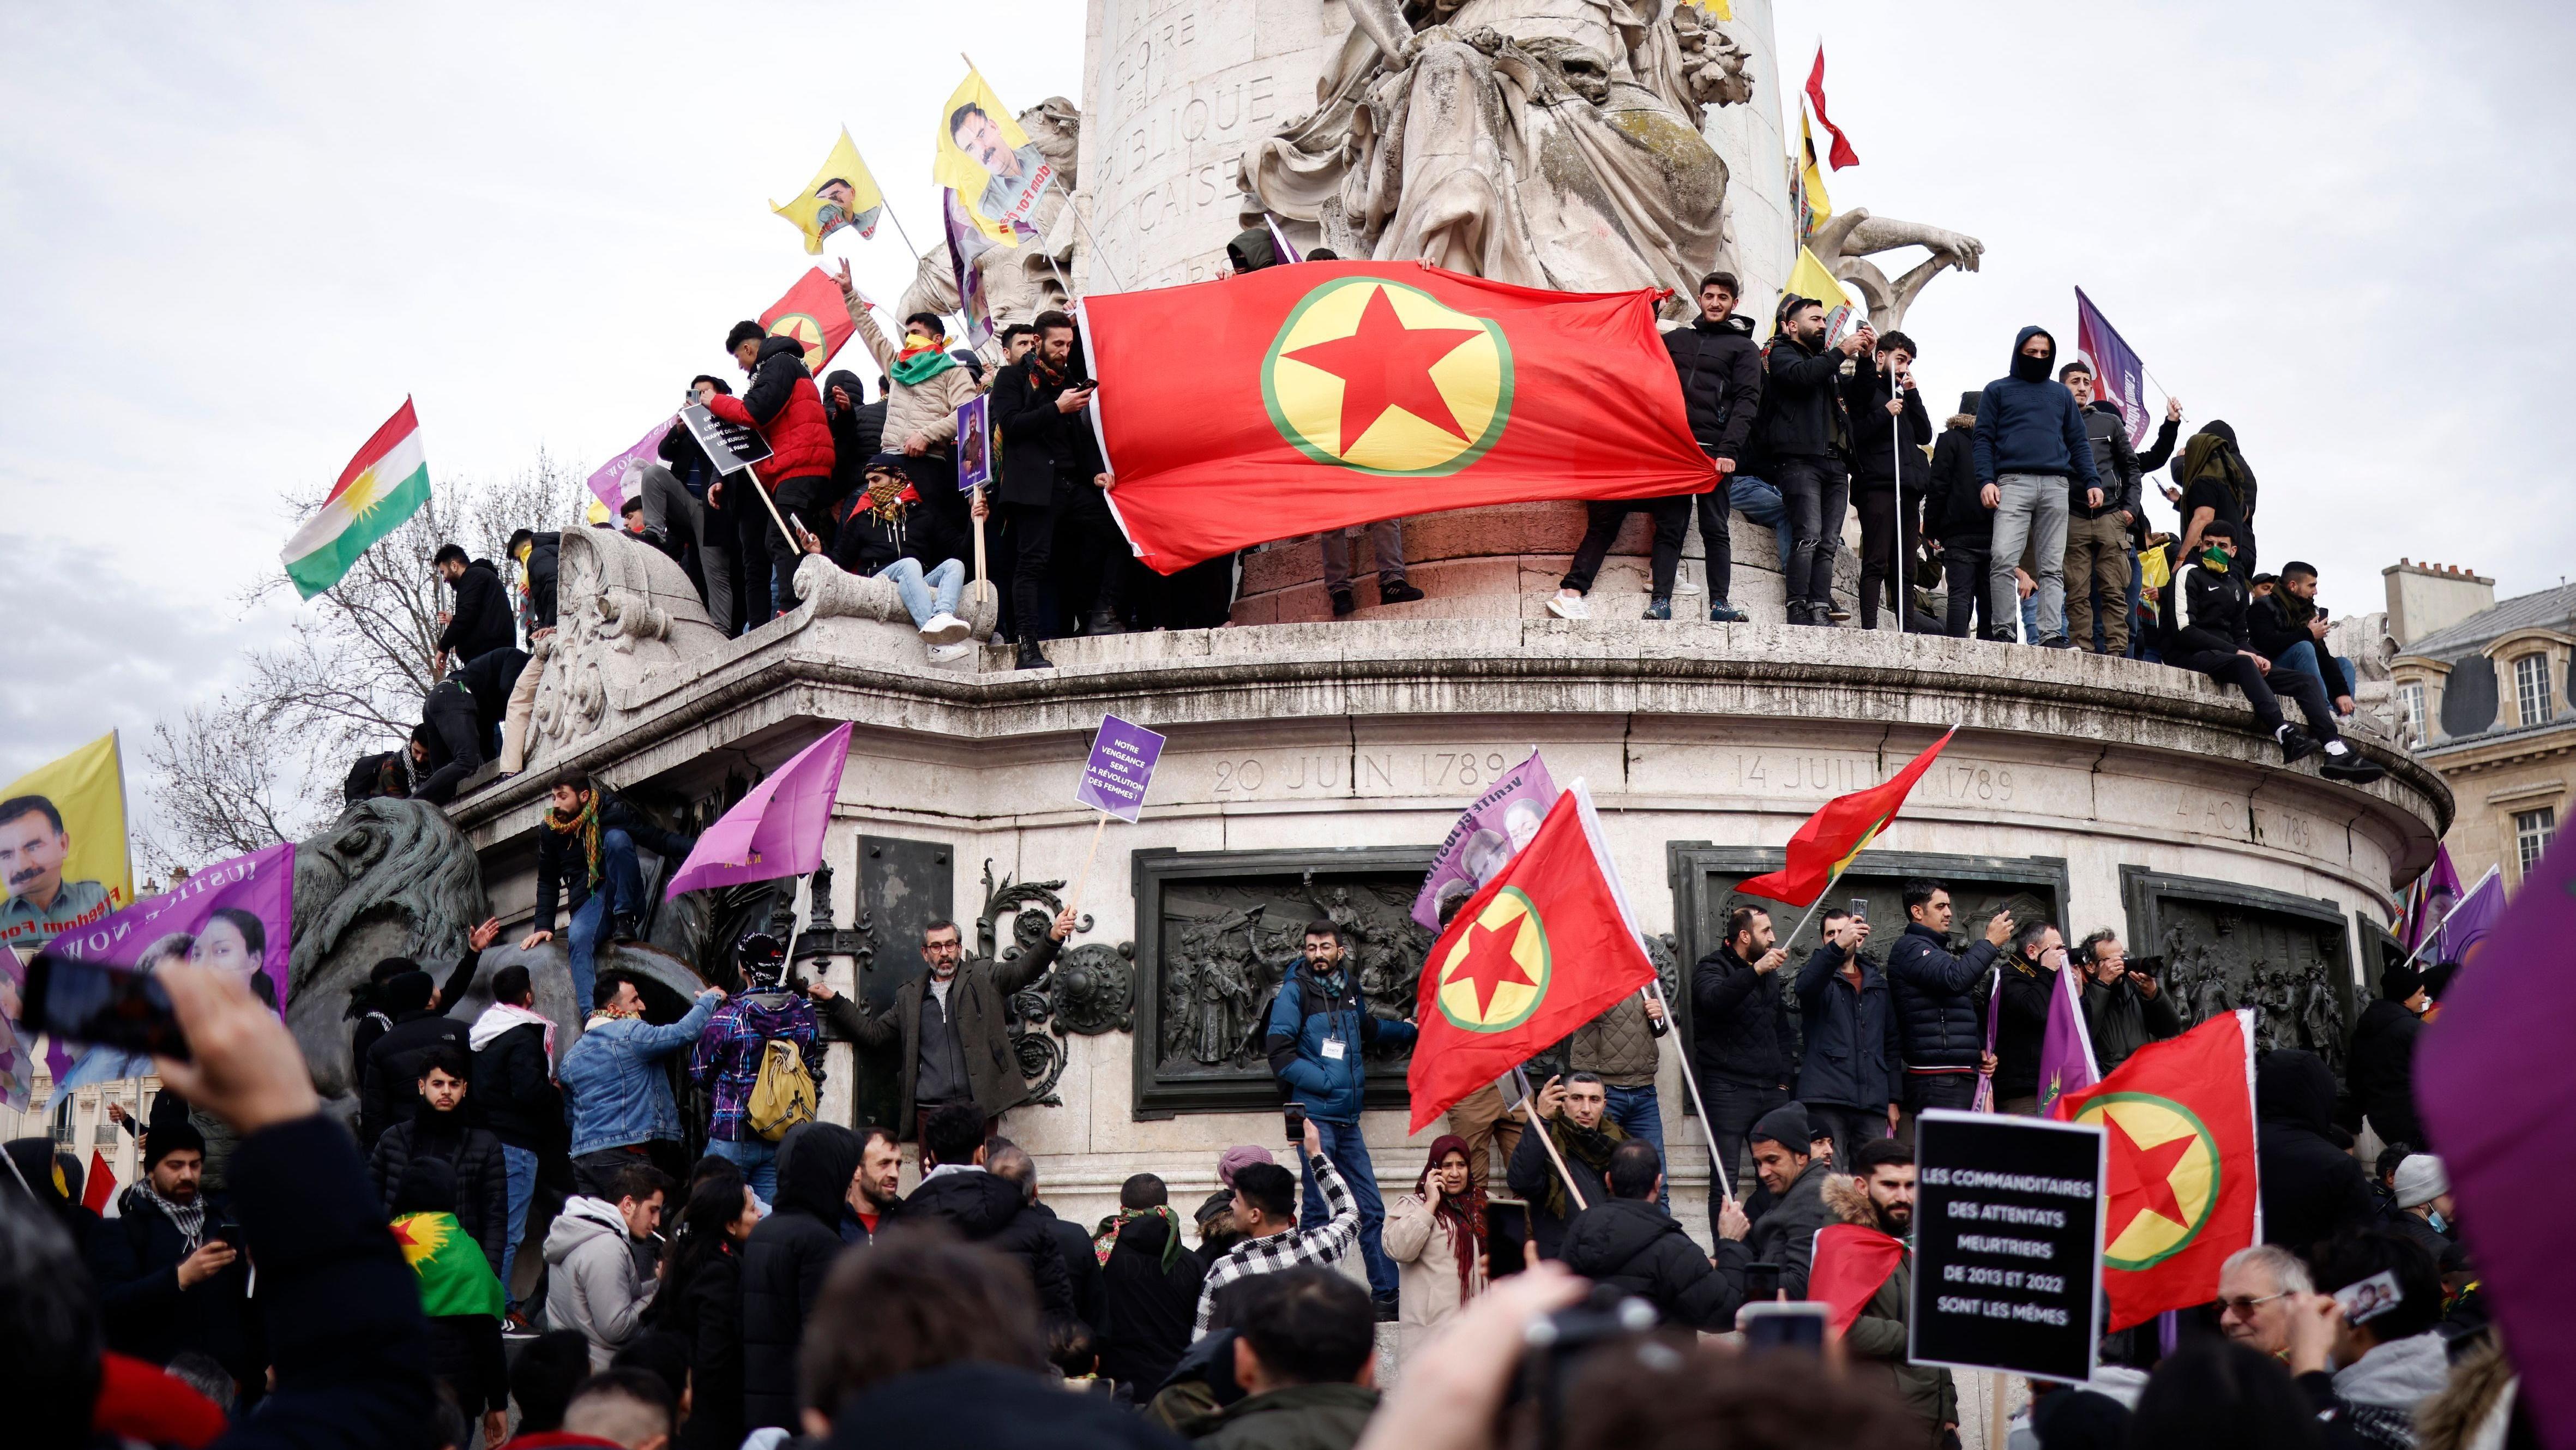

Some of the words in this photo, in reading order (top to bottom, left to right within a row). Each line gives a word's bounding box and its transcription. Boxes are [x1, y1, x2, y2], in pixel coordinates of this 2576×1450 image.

[1115, 14, 1195, 91] GLOIRE
[702, 430, 724, 442] FRAPPÉ
[727, 435, 749, 443] KURDES
[1102, 745, 1146, 768] VENGEANCE
[1114, 739, 1139, 754] NOTRE
[1087, 764, 1097, 774] LA
[1098, 769, 1144, 792] RÉVOLUTION
[1109, 761, 1129, 774] SERA
[1214, 759, 1264, 792] 20
[1422, 753, 1506, 786] 1789
[1737, 754, 1766, 788] 14
[1946, 766, 2014, 801] 1789
[1088, 777, 1103, 787] DES
[1103, 783, 1133, 799] FEMMES
[2276, 813, 2310, 847] 1789
[1922, 1168, 1950, 1186] LES
[1952, 1170, 2095, 1199] COMMANDITAIRES
[1947, 1201, 1979, 1220] DES
[1981, 1203, 2067, 1229] ATTENTATS
[1957, 1234, 2055, 1260] MEURTRIERS
[1943, 1264, 1965, 1282] DE
[1967, 1267, 2003, 1287] 2013
[2005, 1271, 2024, 1288] ET
[2026, 1273, 2065, 1294] 2022
[1937, 1296, 1982, 1314] SONT
[1982, 1299, 2011, 1320] LES
